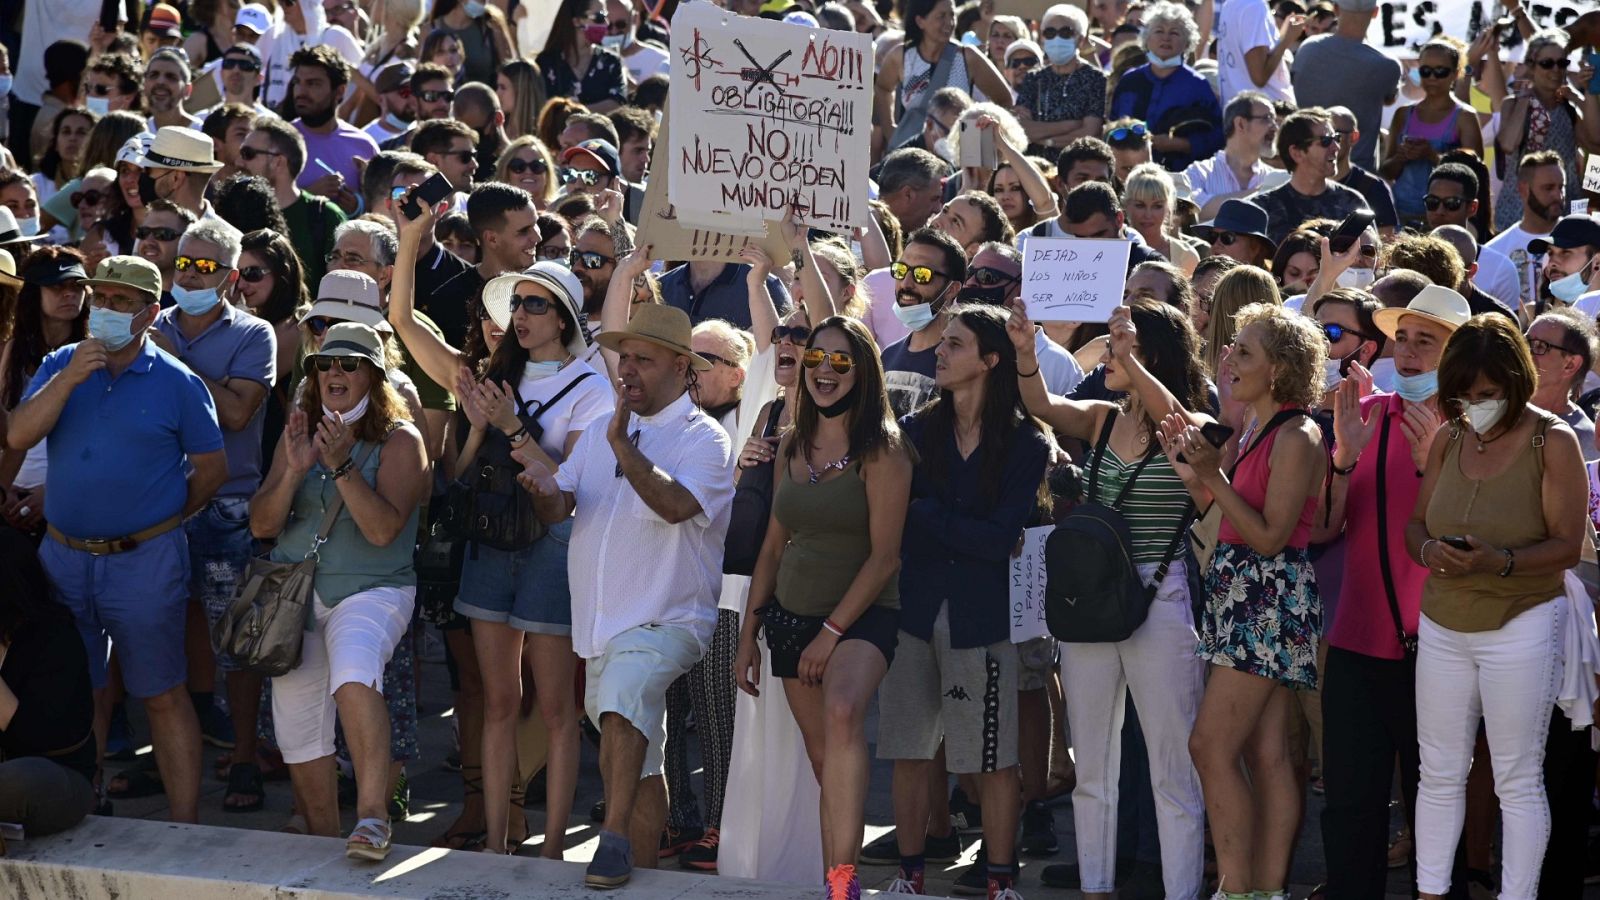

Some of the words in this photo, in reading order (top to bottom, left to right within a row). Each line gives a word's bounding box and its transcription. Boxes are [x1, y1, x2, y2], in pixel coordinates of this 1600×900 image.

[682, 133, 765, 180] NUEVO
[769, 159, 846, 193] ORDEN
[1033, 249, 1078, 262] DEJAD
[1092, 250, 1104, 263] A
[1029, 271, 1051, 282] LOS
[1063, 270, 1099, 281] NIÑOS
[1032, 293, 1053, 303] SER
[1065, 290, 1099, 303] NIÑOS
[1013, 561, 1022, 588] MA
[1025, 554, 1033, 610] FALSOS
[1037, 533, 1047, 623] POSITIVOS
[1013, 601, 1024, 627] NO
